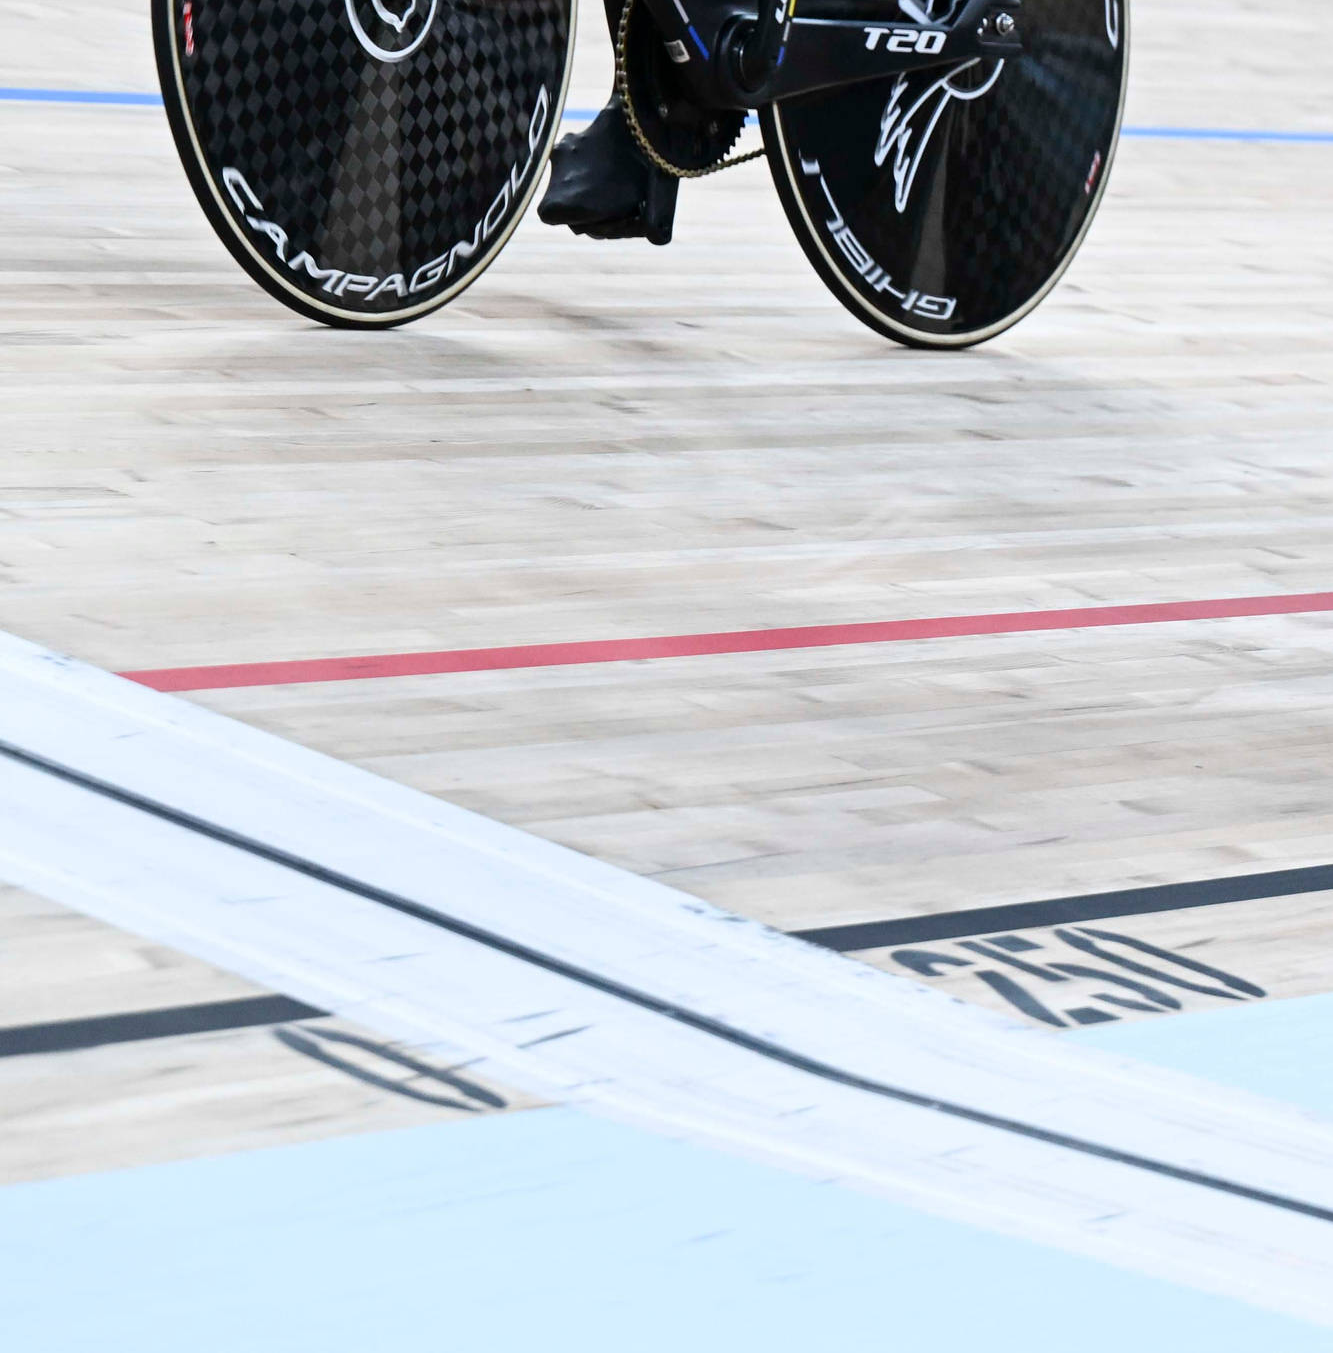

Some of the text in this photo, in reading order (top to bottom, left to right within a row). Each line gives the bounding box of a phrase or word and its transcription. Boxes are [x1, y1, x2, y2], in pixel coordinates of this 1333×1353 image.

[864, 27, 947, 55] T20
[222, 83, 550, 301] CAMPAGNOLO
[799, 149, 957, 320] GHIBLI
[889, 925, 1269, 1028] 250
